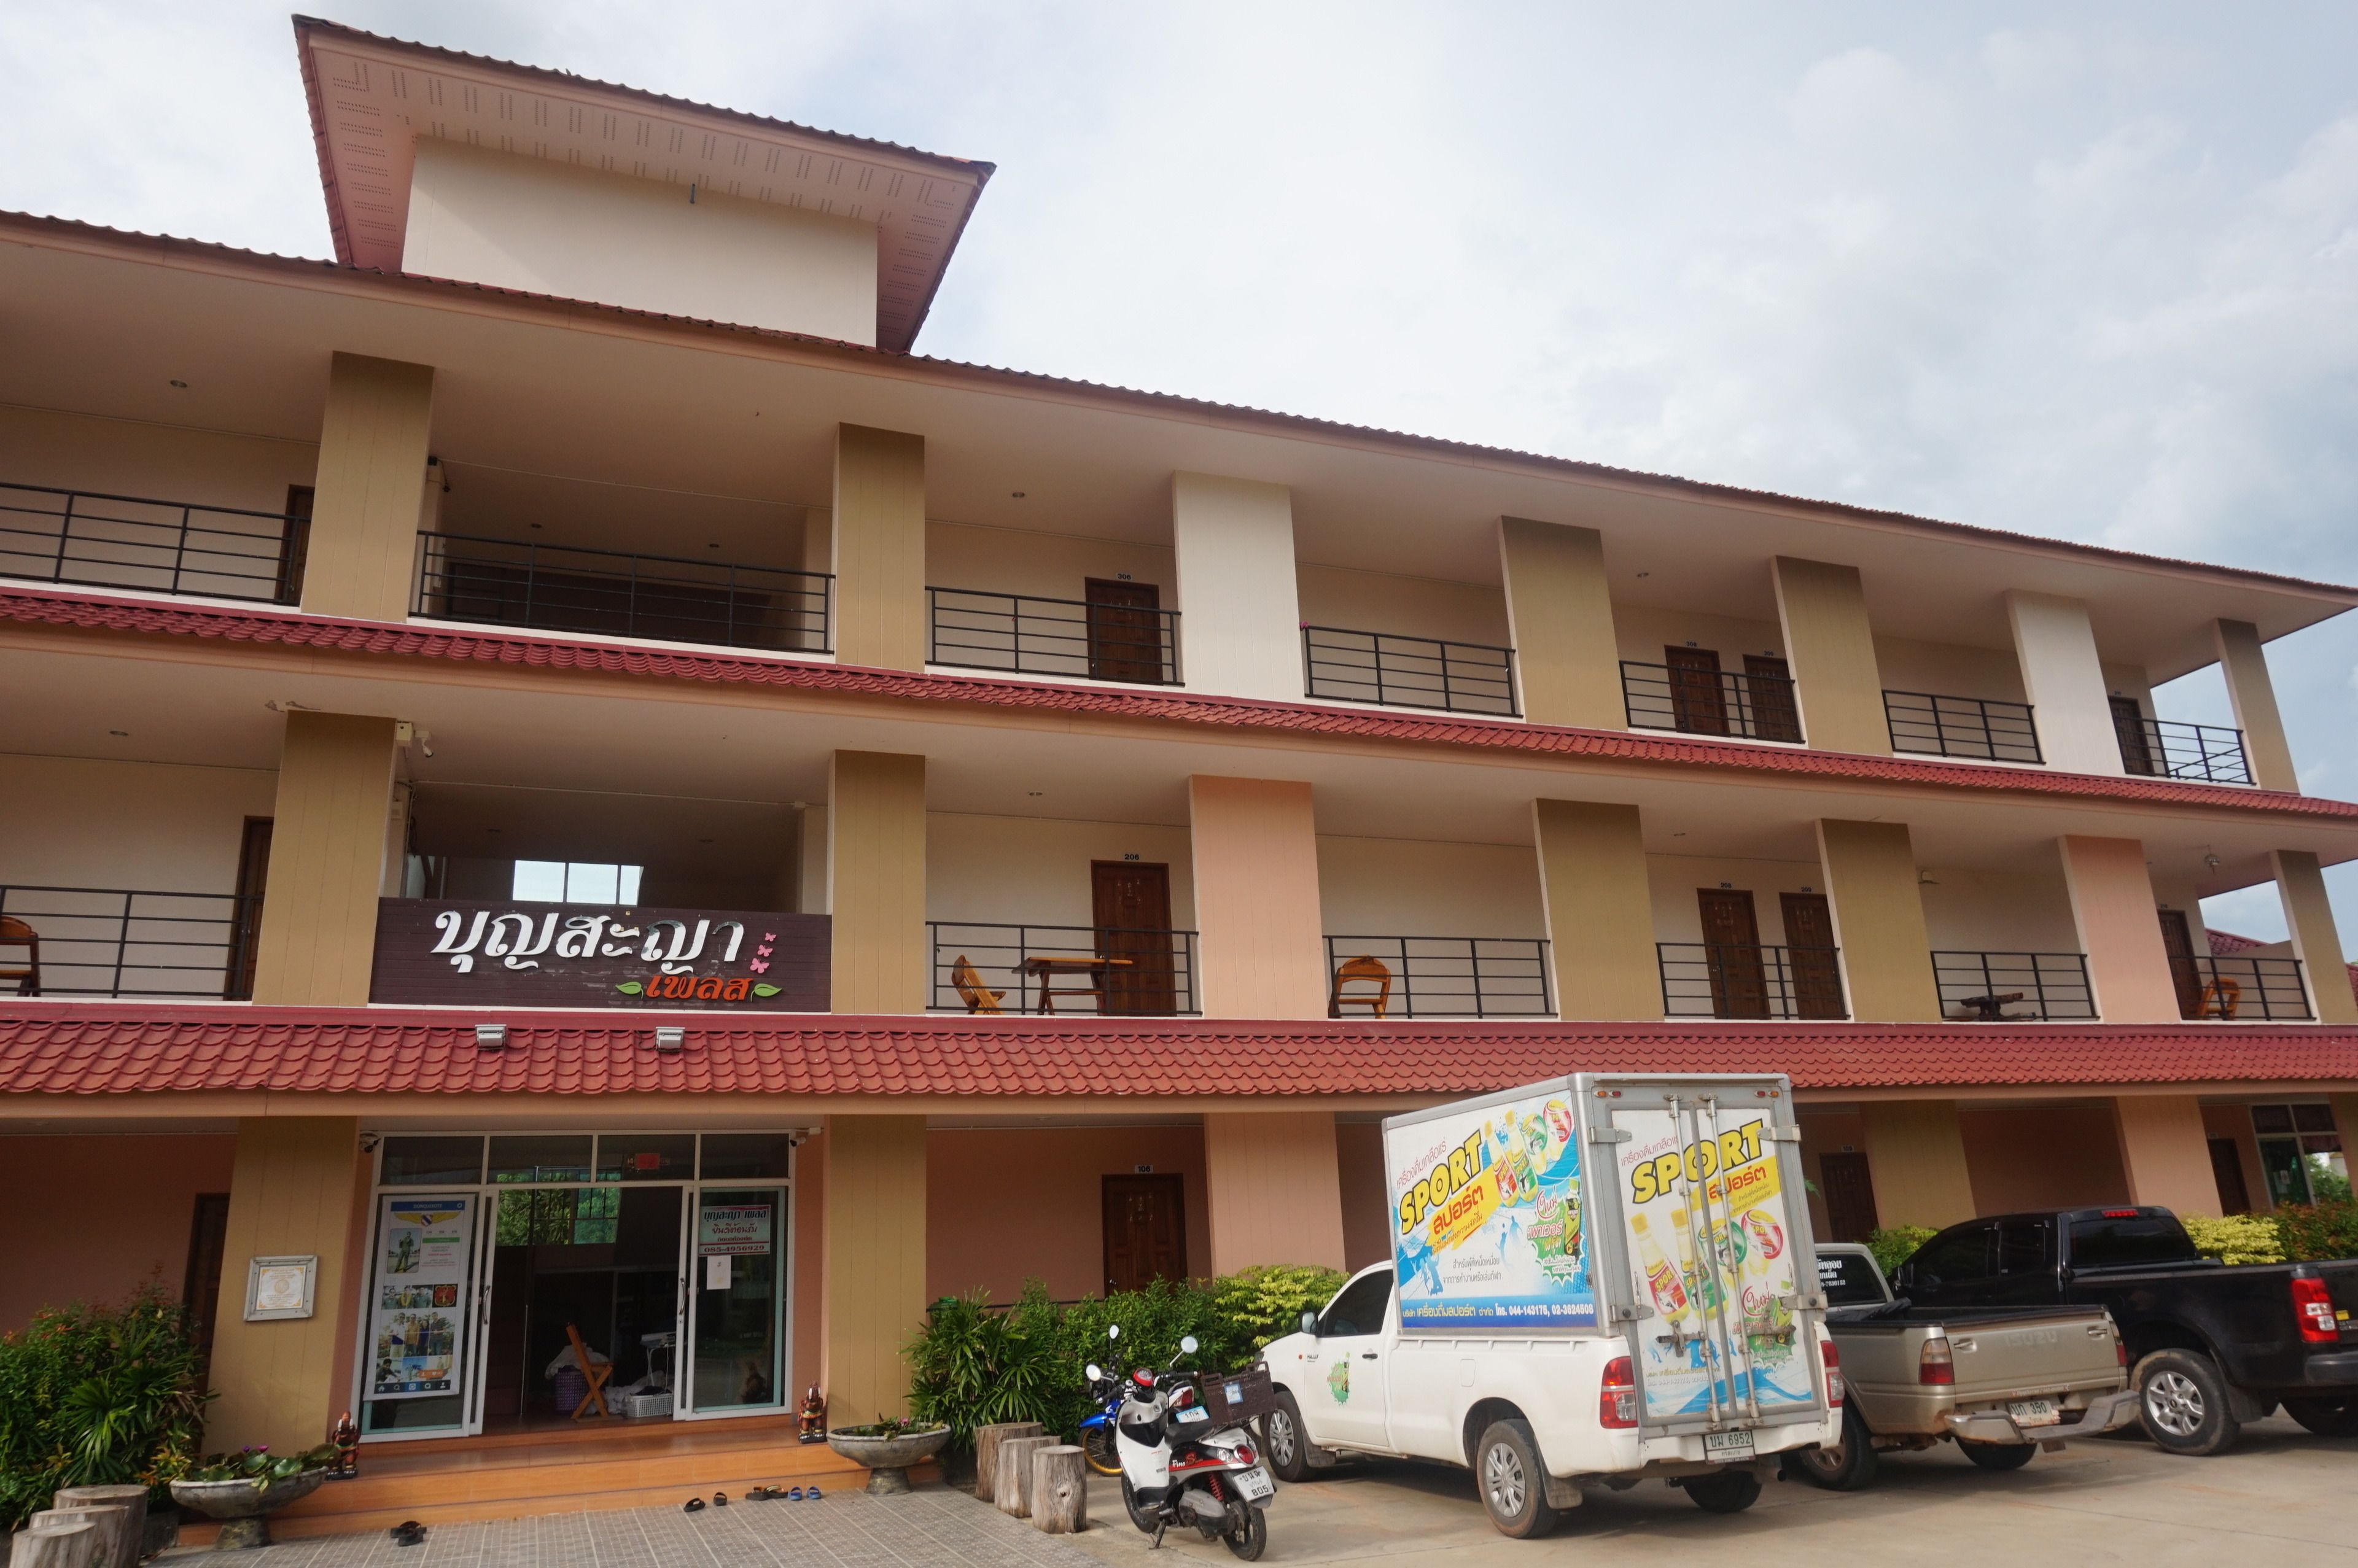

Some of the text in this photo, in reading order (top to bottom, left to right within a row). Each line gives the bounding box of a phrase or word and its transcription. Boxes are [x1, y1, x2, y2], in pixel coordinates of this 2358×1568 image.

[430, 909, 745, 975] บุญสะญา
[645, 972, 752, 1001] เพลส
[1396, 1136, 1447, 1190] เครื่องดื่มเกลือแร่
[1631, 1119, 1763, 1204] SPORT
[1399, 1128, 1482, 1235] SPORT
[1433, 1184, 1484, 1235] สปอร์ต
[1443, 1270, 1501, 1284] จากการทำงานหรือเล่นกีฬา
[1417, 1302, 1476, 1317] เครื่องดื่มสปอร์ต
[1495, 1302, 1508, 1316] โทร.
[1509, 1305, 1551, 1318] 044-143175,
[1728, 1432, 1751, 1446] 6952
[1172, 1459, 1186, 1468] Fino
[1251, 1485, 1269, 1496] 805
